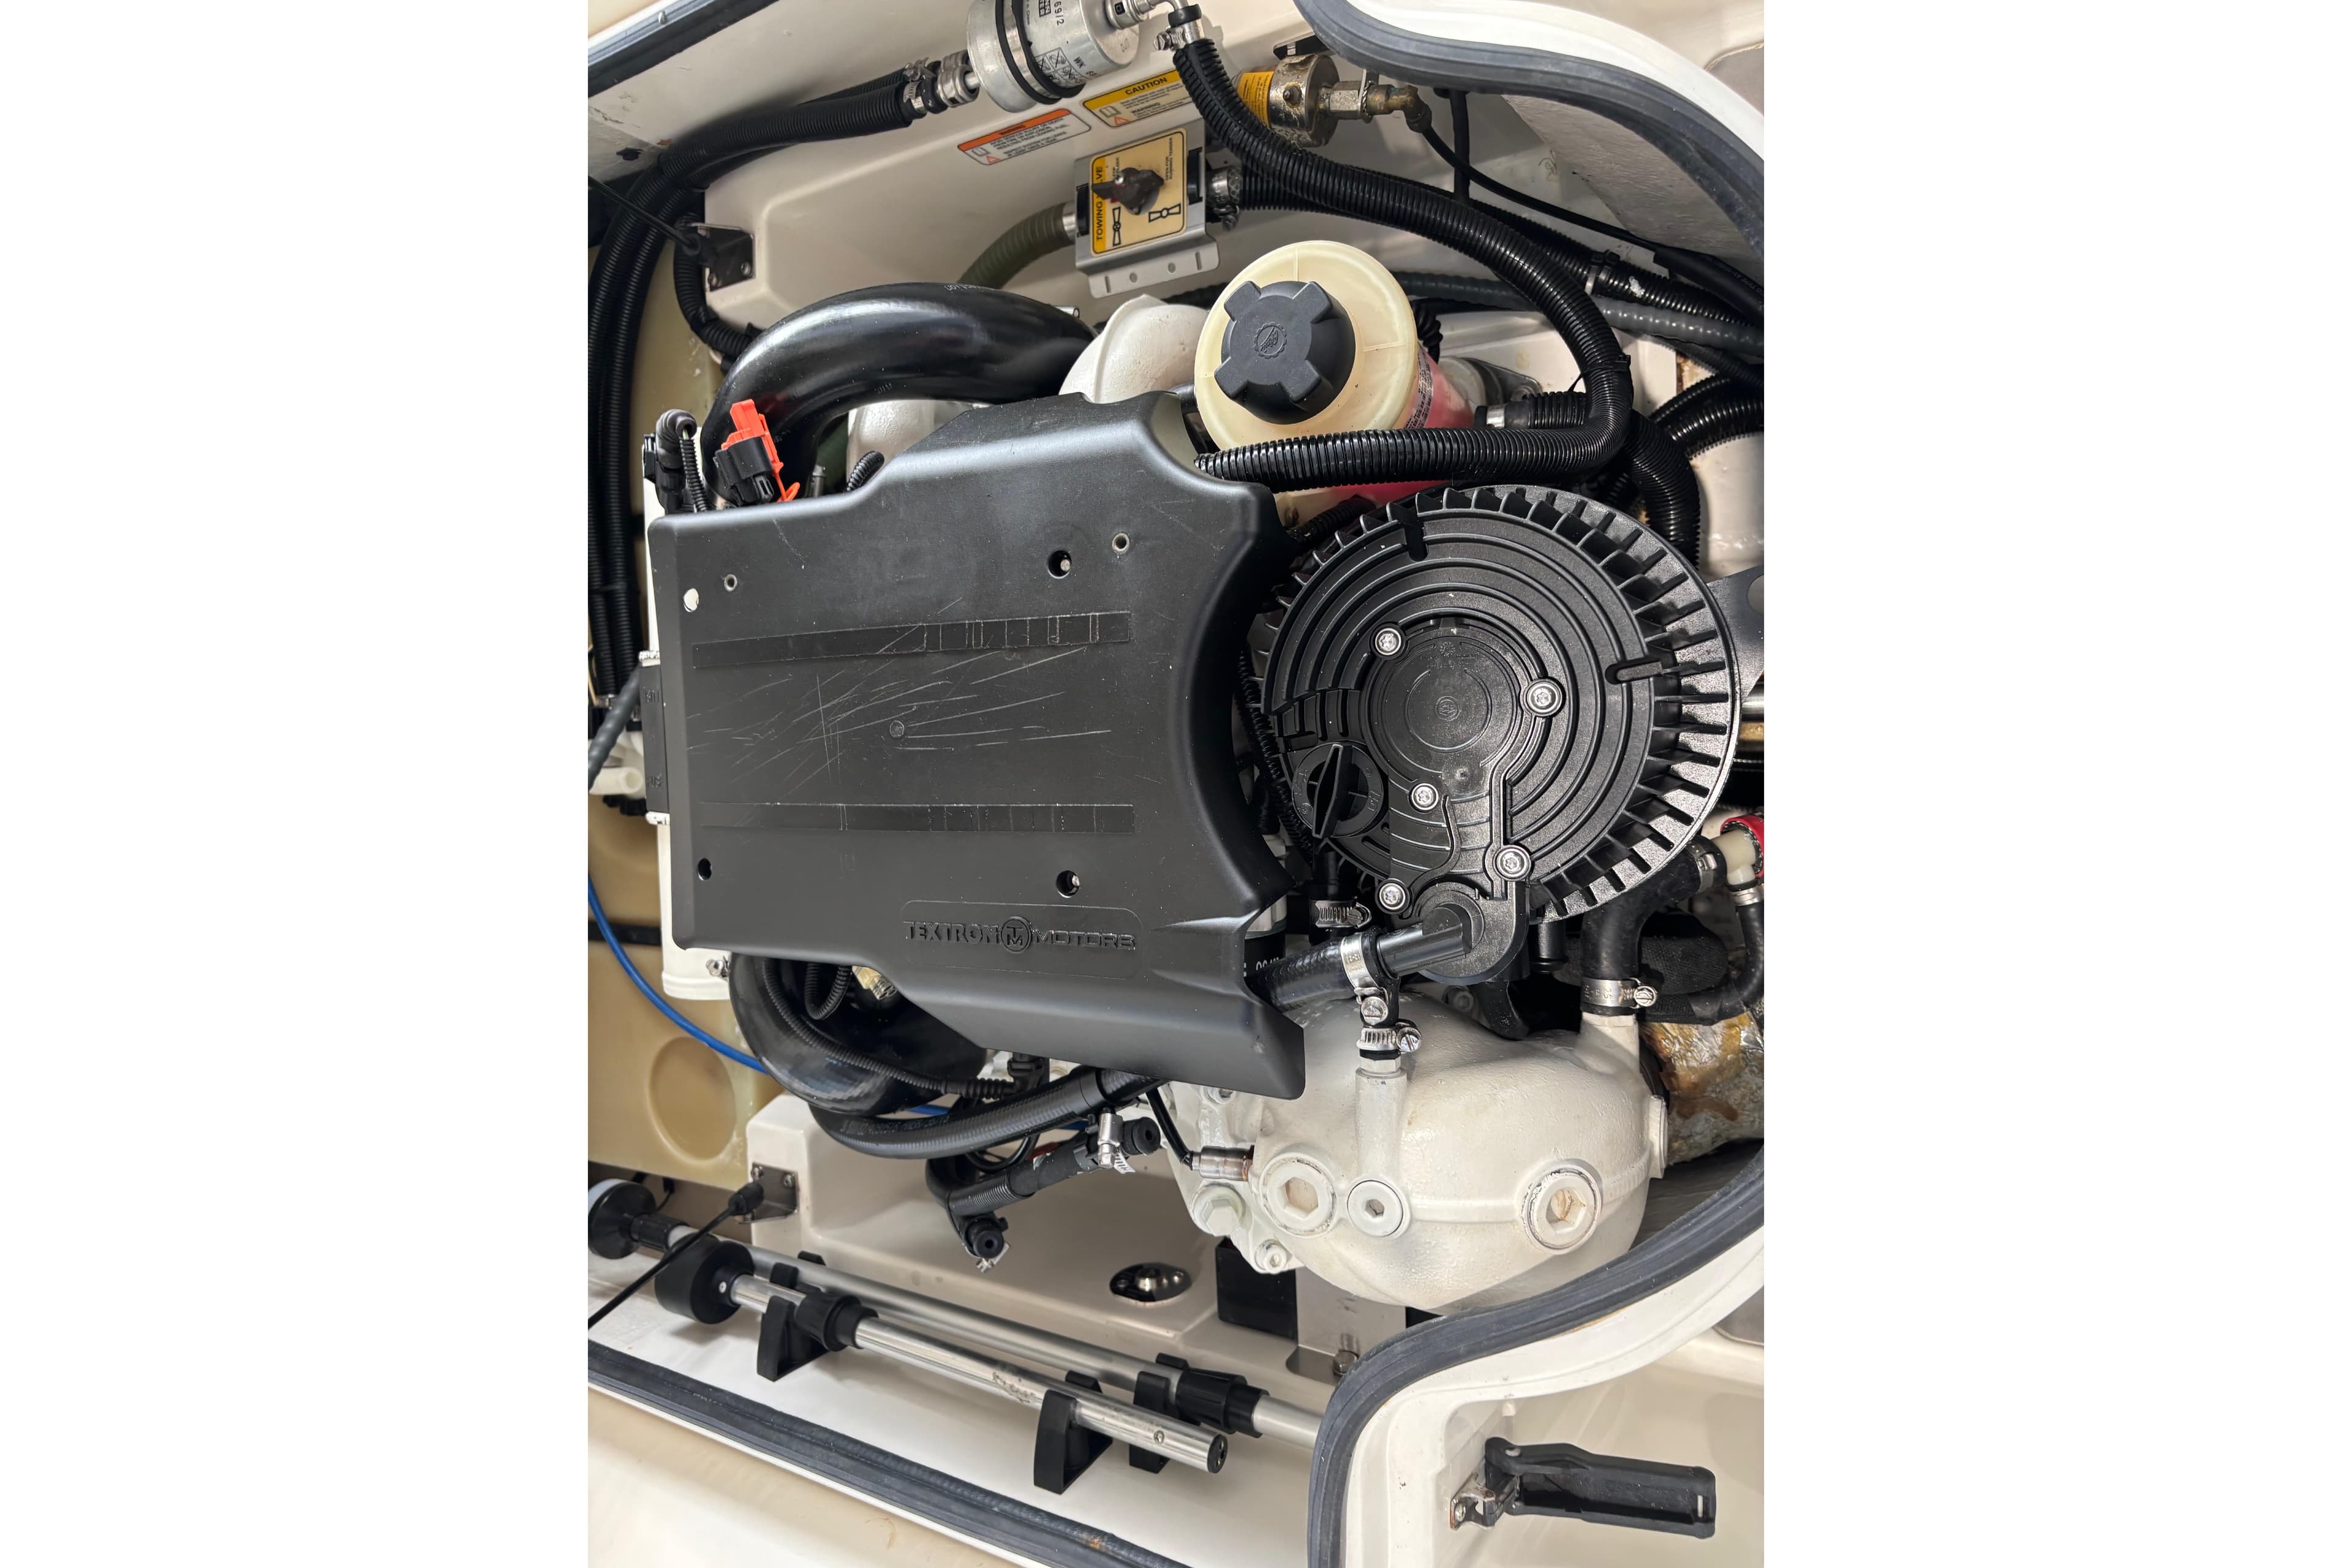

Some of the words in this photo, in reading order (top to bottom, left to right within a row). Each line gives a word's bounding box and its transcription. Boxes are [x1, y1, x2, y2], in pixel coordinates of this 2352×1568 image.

[1125, 77, 1167, 95] CAUTION
[903, 921, 999, 944] TEXTRON
[1033, 929, 1137, 951] MOTORS
